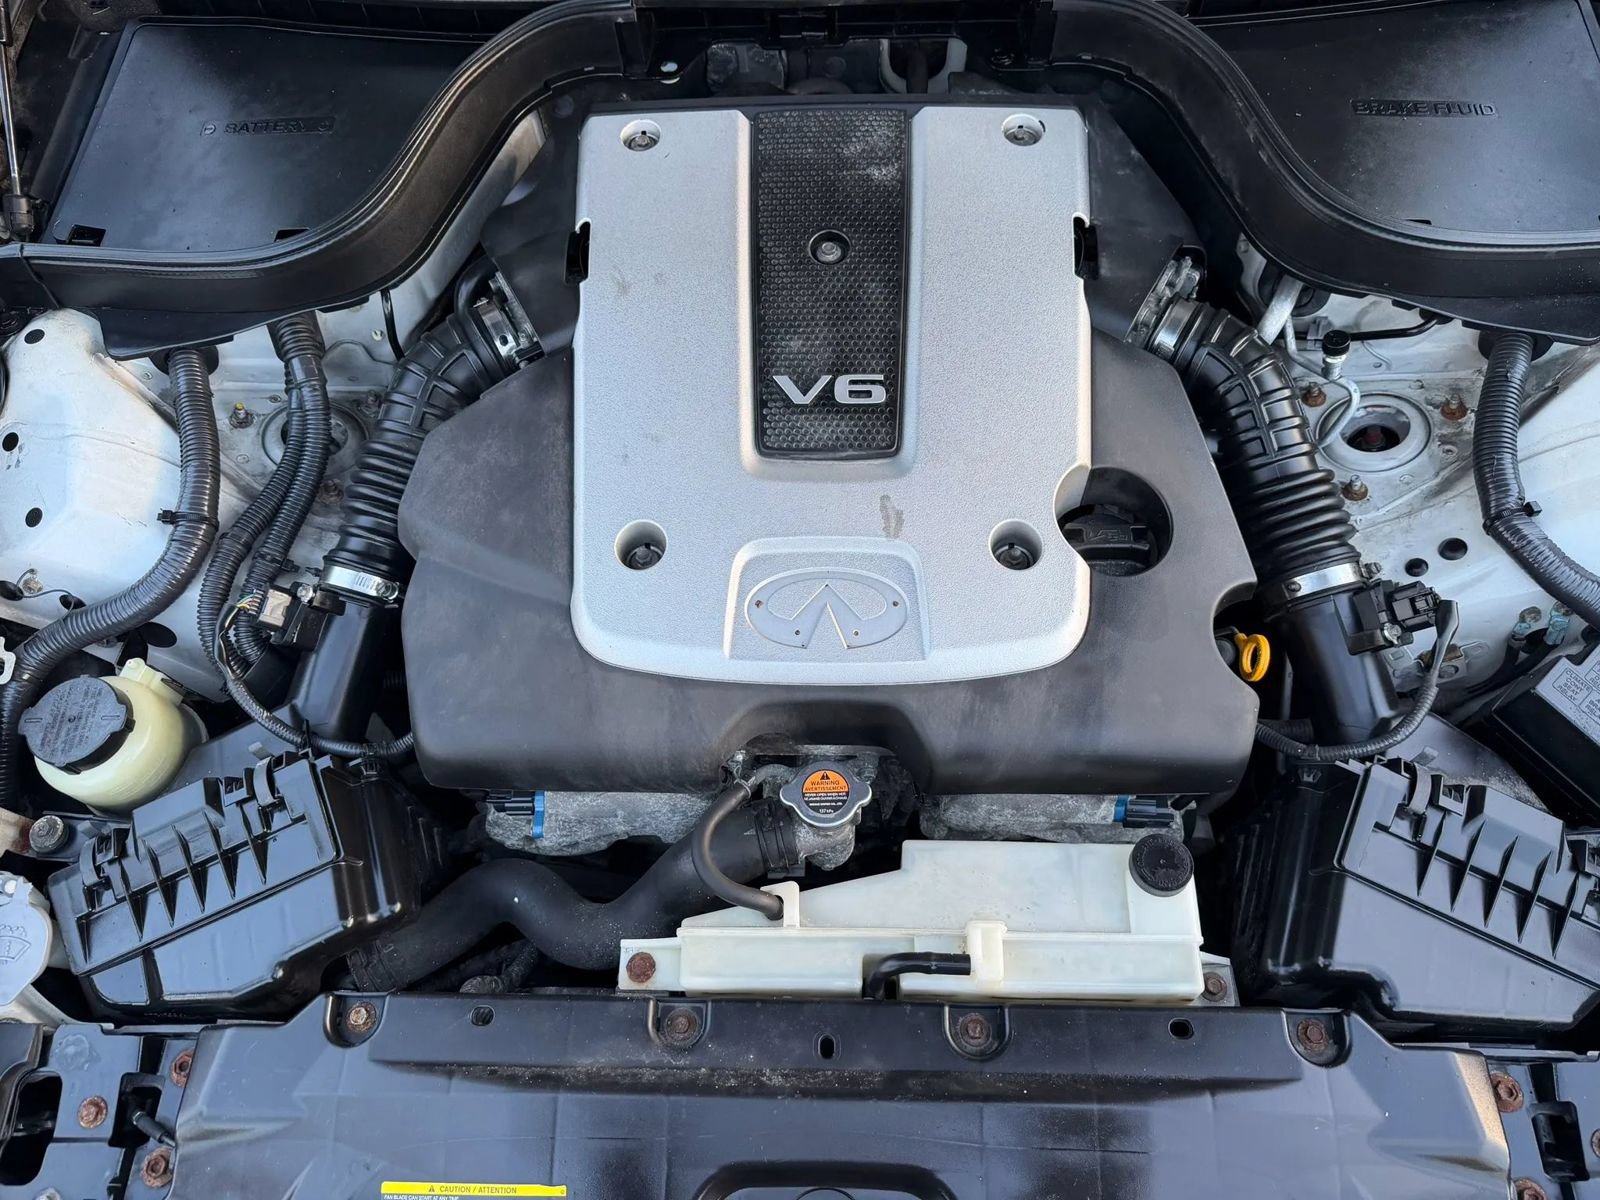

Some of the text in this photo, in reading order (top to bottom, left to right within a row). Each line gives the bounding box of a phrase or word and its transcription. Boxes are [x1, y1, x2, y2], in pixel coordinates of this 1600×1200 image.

[1355, 102, 1496, 116] BRAKE FLUID
[772, 374, 887, 405] V6
[1562, 681, 1579, 696] SEAT
[1565, 669, 1591, 692] CLIMATE
[1565, 676, 1583, 693] CONT
[1556, 684, 1577, 702] RELAY
[478, 1186, 517, 1194] ATTENTION
